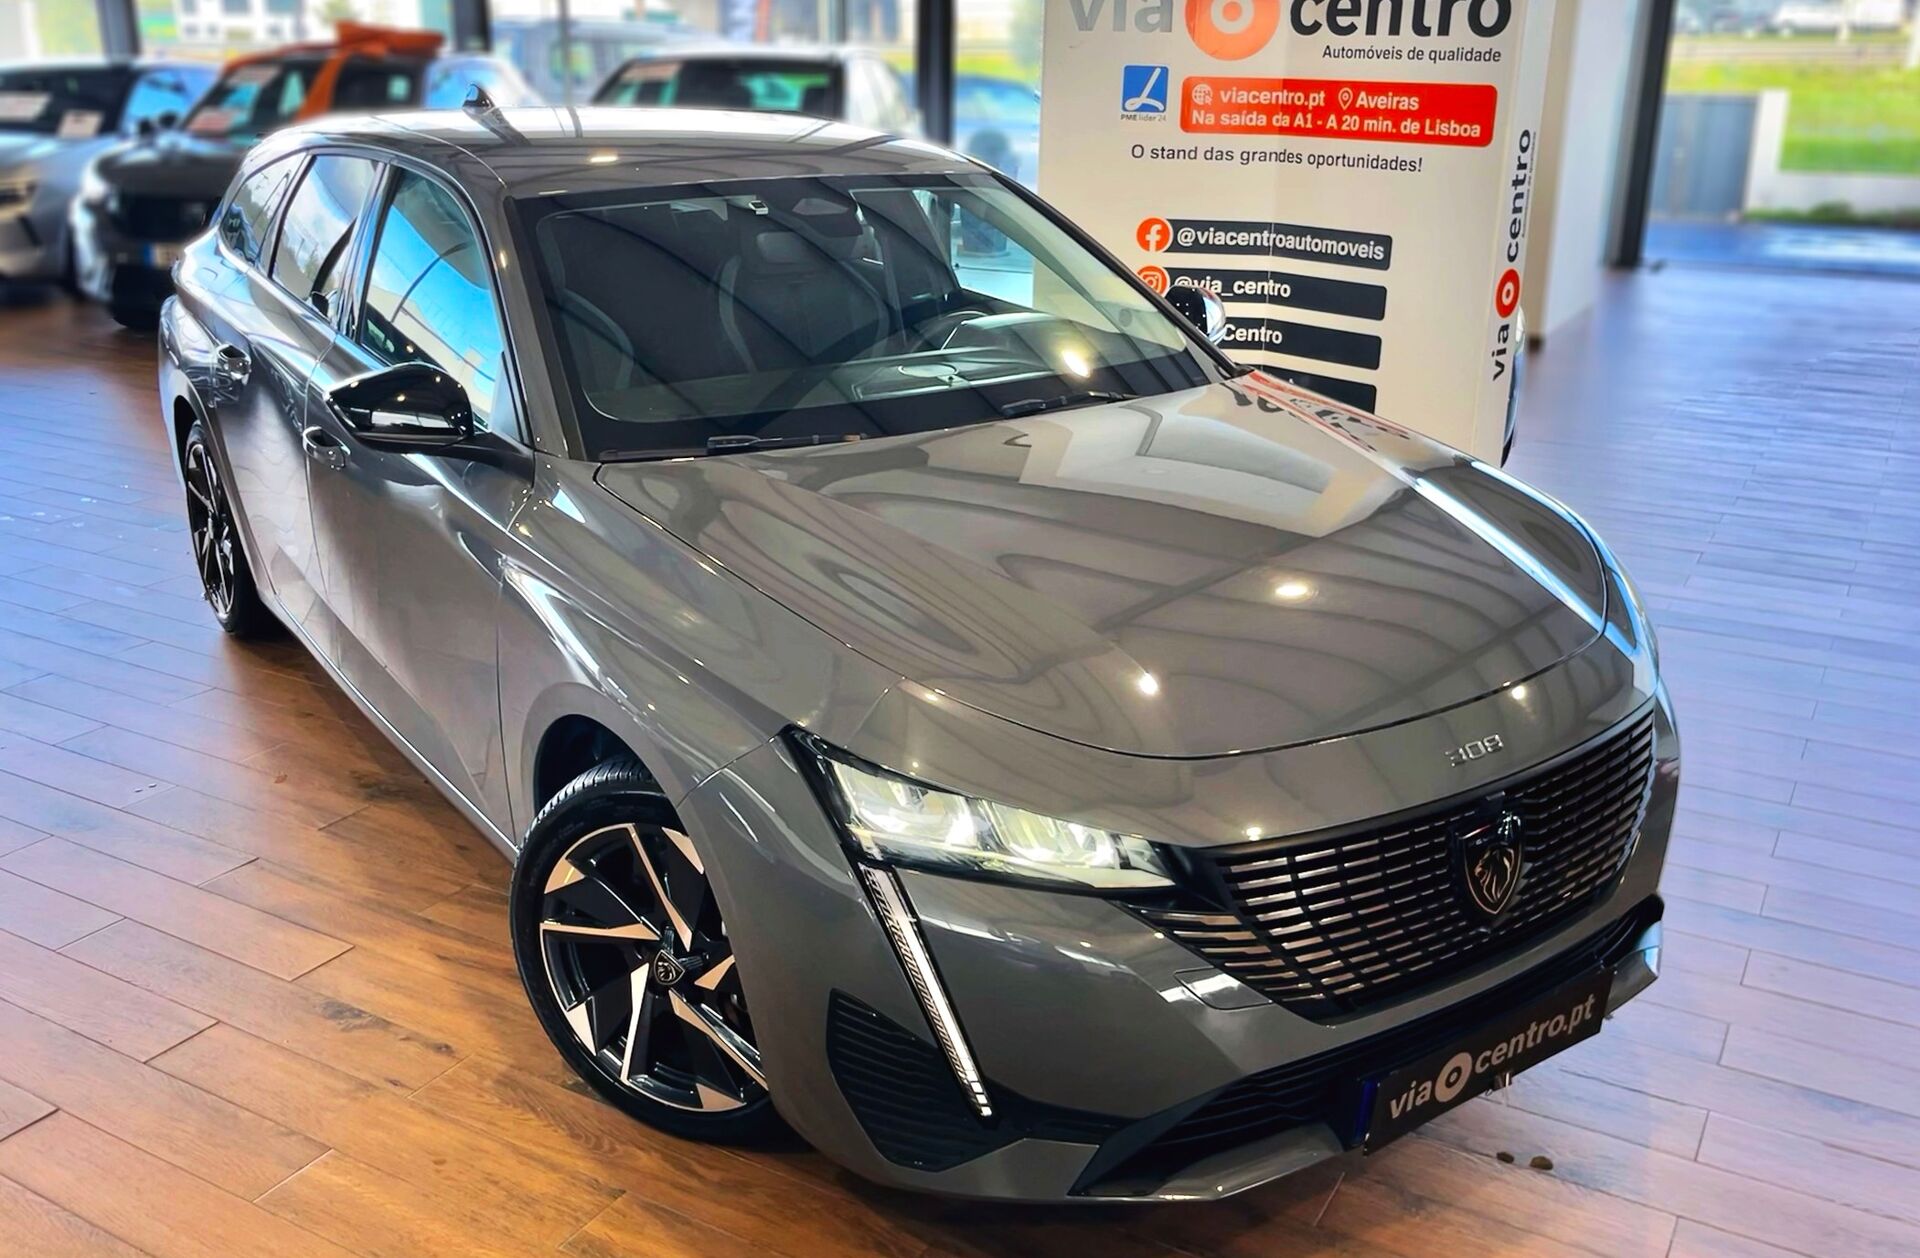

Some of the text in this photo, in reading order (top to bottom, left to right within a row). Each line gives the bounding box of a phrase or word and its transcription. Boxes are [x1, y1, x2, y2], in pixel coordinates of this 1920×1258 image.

[1290, 0, 1512, 38] centro
[1322, 44, 1502, 64] Automóveis de qualidade
[1220, 87, 1420, 111] viacentro.pt Aveiras
[1191, 109, 1215, 125] Na
[1220, 110, 1267, 127] saída
[1272, 112, 1290, 127] da
[1294, 112, 1313, 129] A1
[1326, 114, 1338, 130] A
[1341, 115, 1360, 131] 20
[1363, 116, 1396, 134] min.
[1400, 118, 1420, 135] de
[1424, 119, 1481, 138] Lisboa
[1131, 143, 1423, 173] O stand das grandes oportunidades!
[1177, 227, 1384, 261] @viacentroautomoveis
[1491, 323, 1510, 381] via
[1507, 129, 1531, 263] centro
[1390, 993, 1595, 1119] via centro.pt
